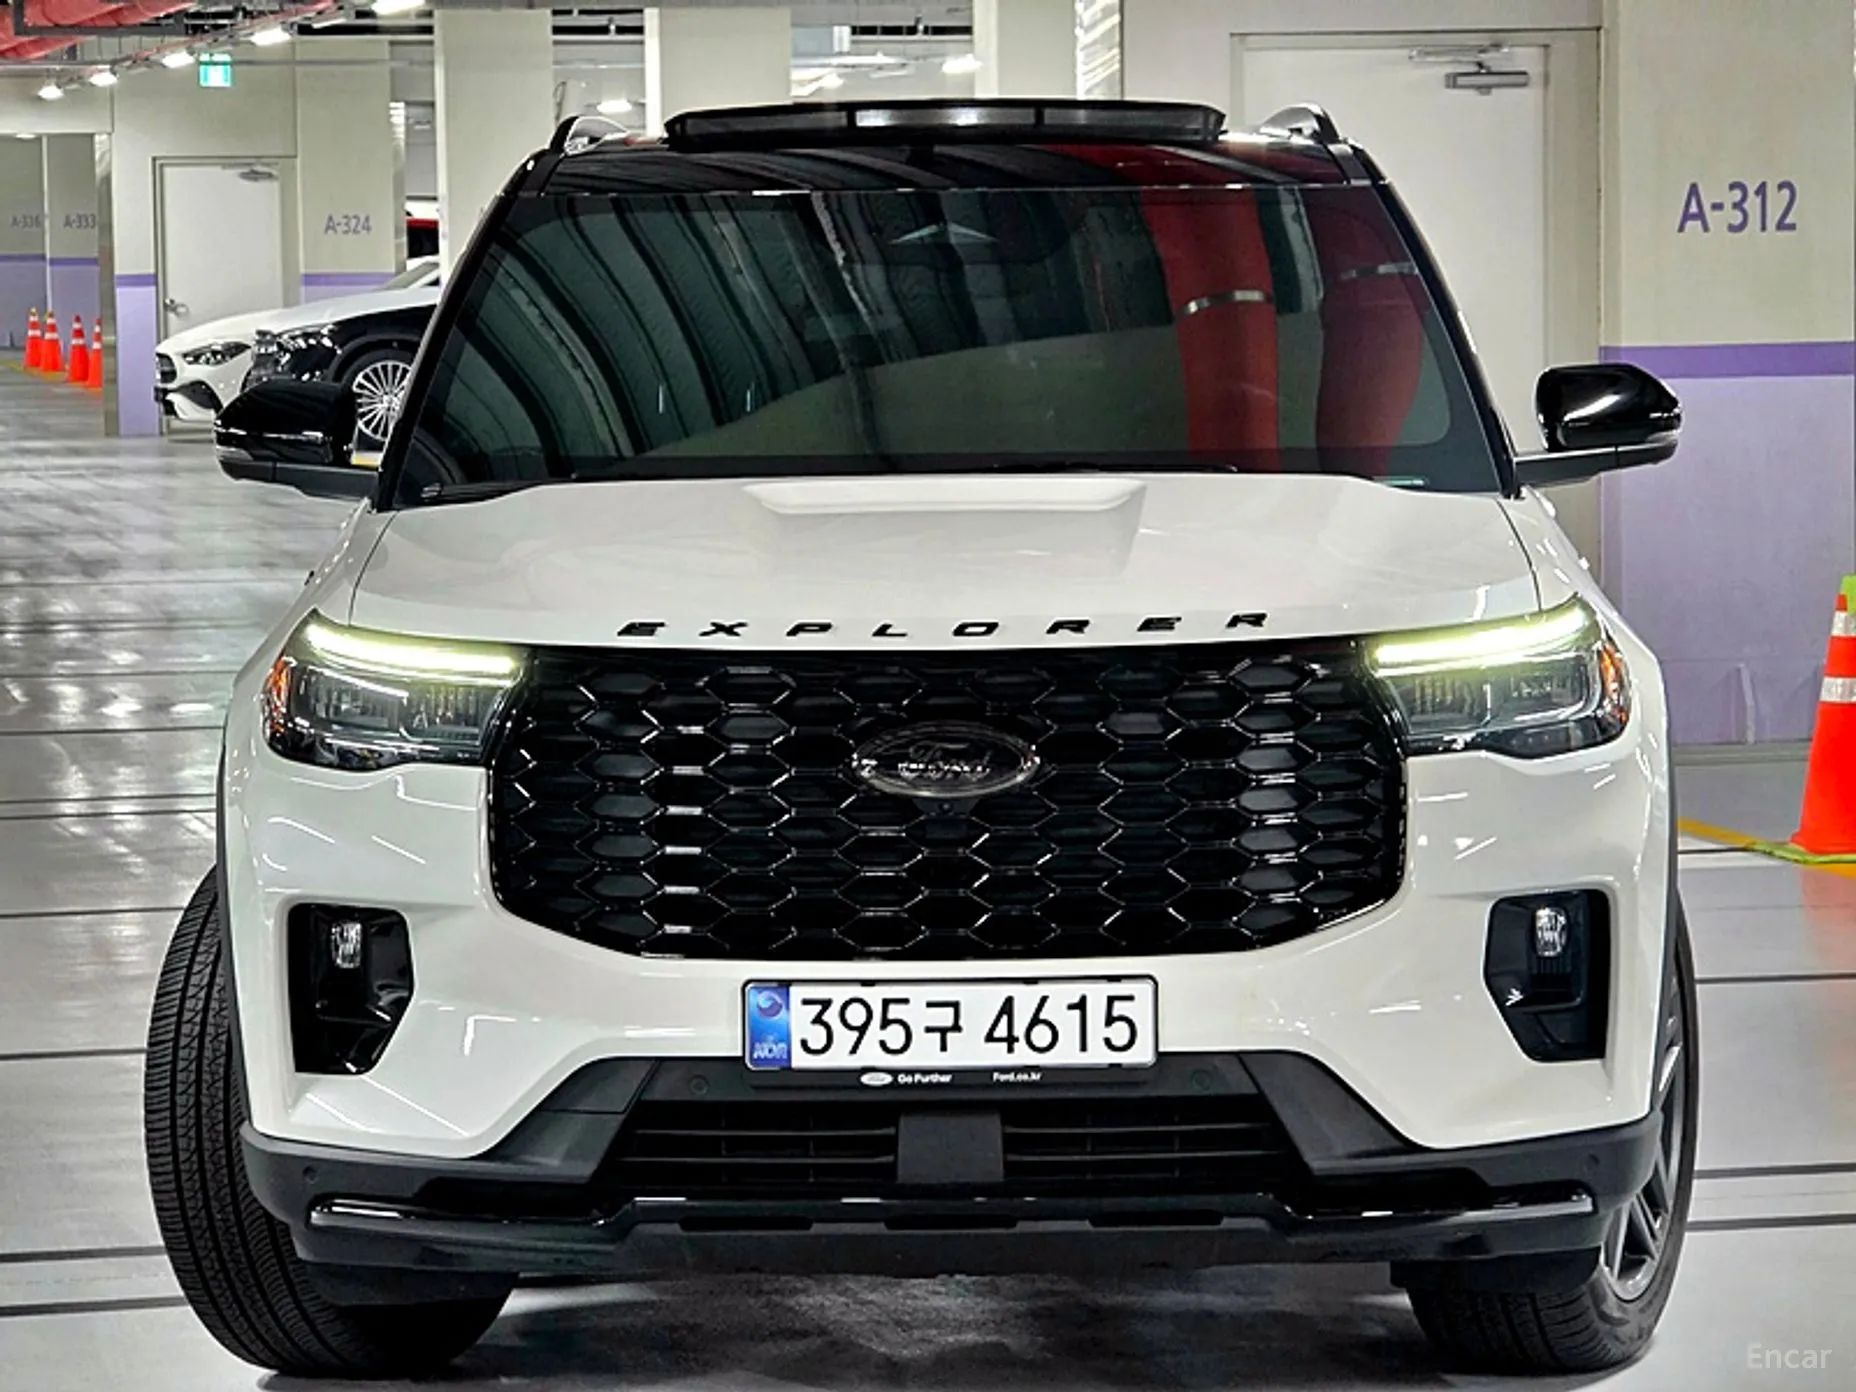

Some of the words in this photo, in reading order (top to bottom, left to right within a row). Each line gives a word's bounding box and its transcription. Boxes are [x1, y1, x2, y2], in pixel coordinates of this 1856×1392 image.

[1677, 180, 1797, 233] A-312
[323, 213, 373, 235] A-324
[616, 611, 1269, 637] EXPLORER
[799, 996, 963, 1055] 395구
[983, 994, 1139, 1054] 4615
[897, 1073, 913, 1084] Go
[915, 1072, 953, 1084] Further
